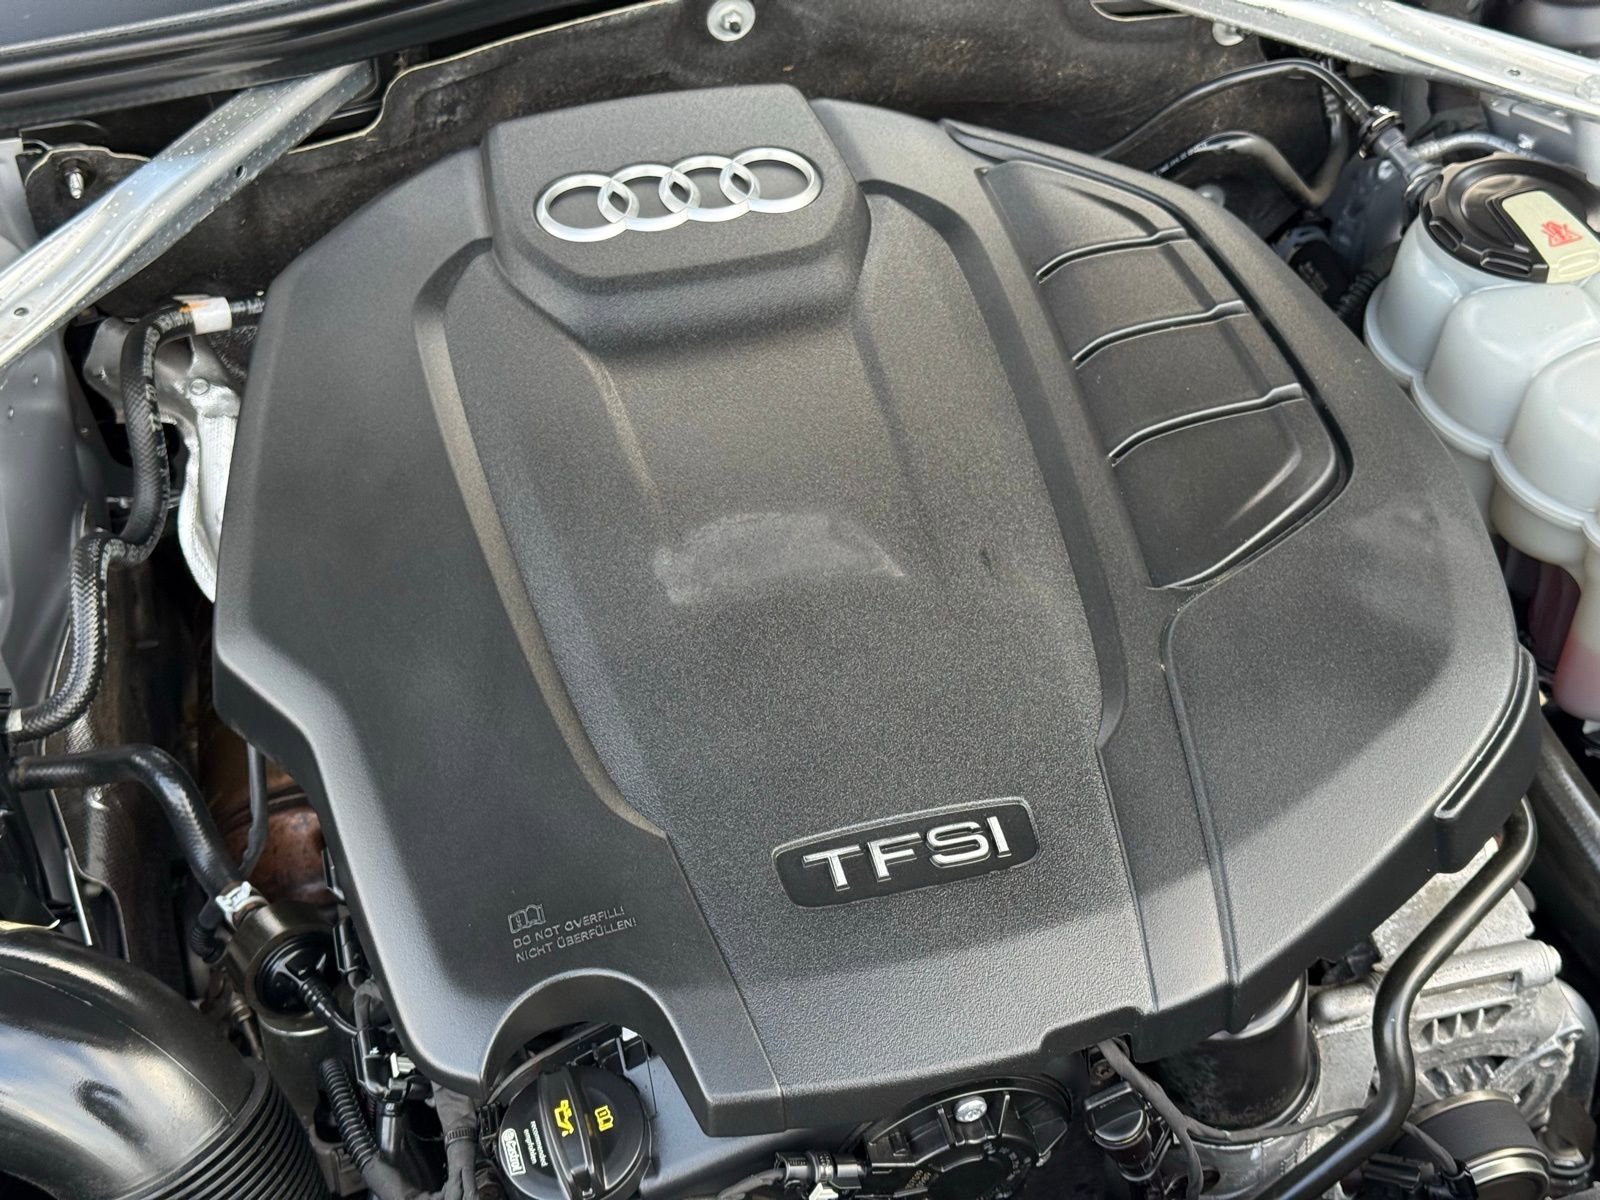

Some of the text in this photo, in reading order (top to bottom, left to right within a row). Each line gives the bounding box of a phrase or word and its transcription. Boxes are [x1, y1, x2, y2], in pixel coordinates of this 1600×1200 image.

[802, 816, 1012, 892] TFSI
[512, 905, 626, 949] DO NOT OVERFILL!
[515, 916, 638, 964] NICHT ÜBERFÜLLEN!
[505, 1140, 522, 1172] Castrol
[530, 1120, 548, 1167] recommended
